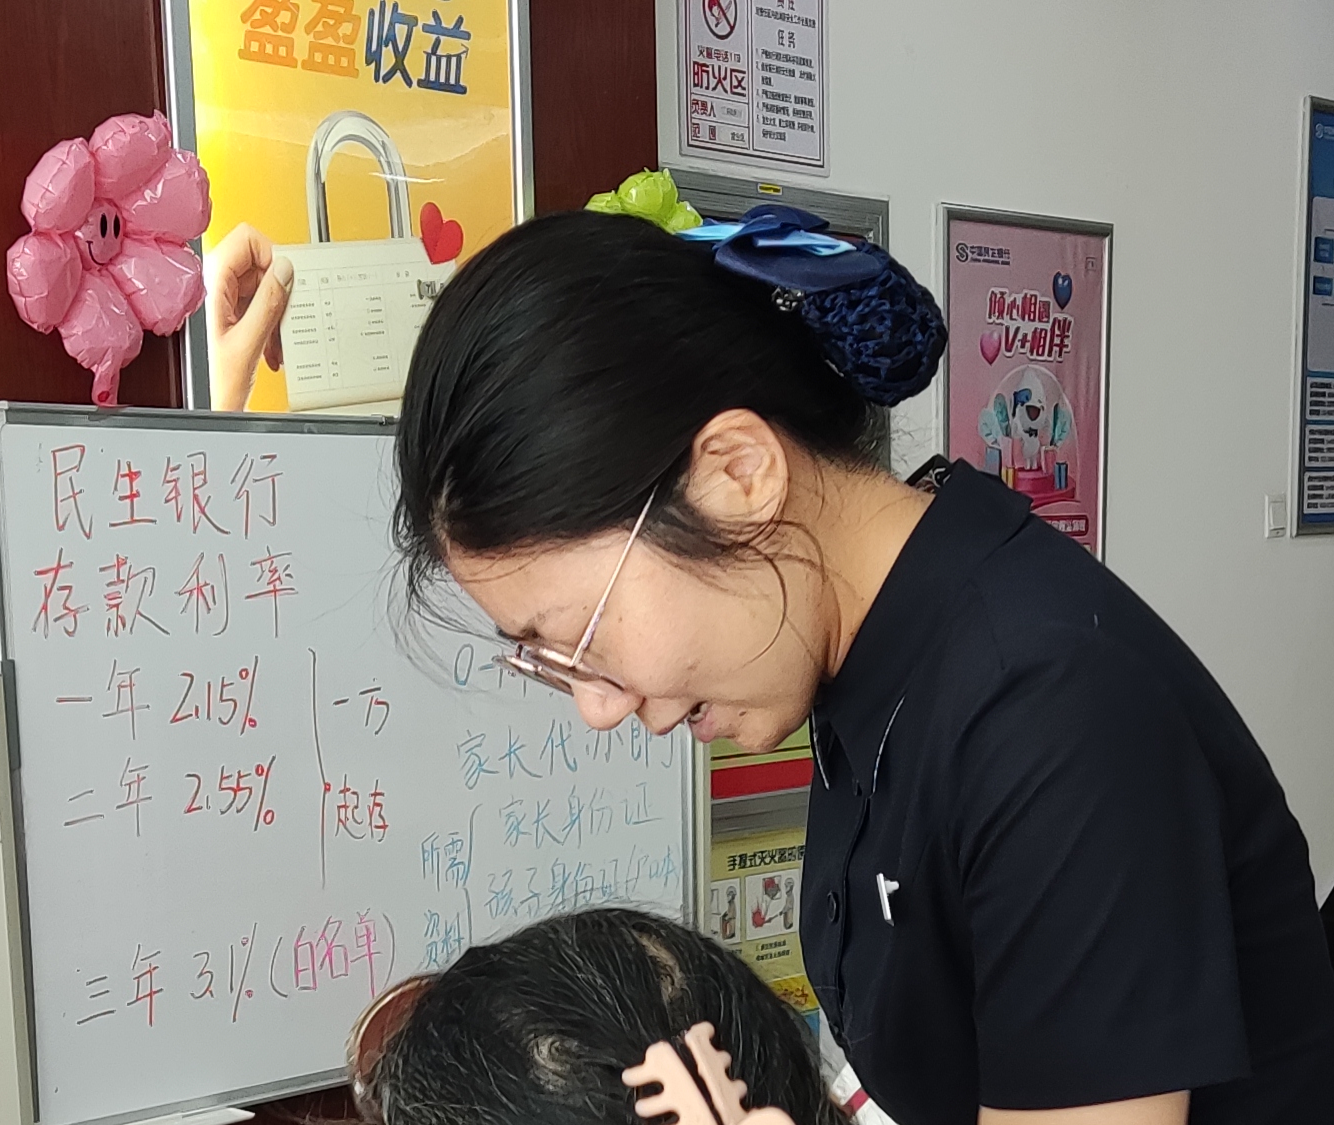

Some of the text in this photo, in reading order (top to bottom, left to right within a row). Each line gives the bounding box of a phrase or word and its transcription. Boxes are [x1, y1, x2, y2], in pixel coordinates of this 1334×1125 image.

[691, 98, 717, 118] 负责人
[692, 61, 747, 97] 防火区
[51, 444, 286, 541] 民生银行
[31, 545, 299, 639] 存款利率
[55, 659, 151, 741] 一年
[169, 655, 261, 732] 2.15%
[63, 755, 390, 843] 二年 2.55% 起存
[499, 783, 664, 849] 家长身份证
[421, 831, 468, 892] 所需
[76, 943, 165, 1027] 三年
